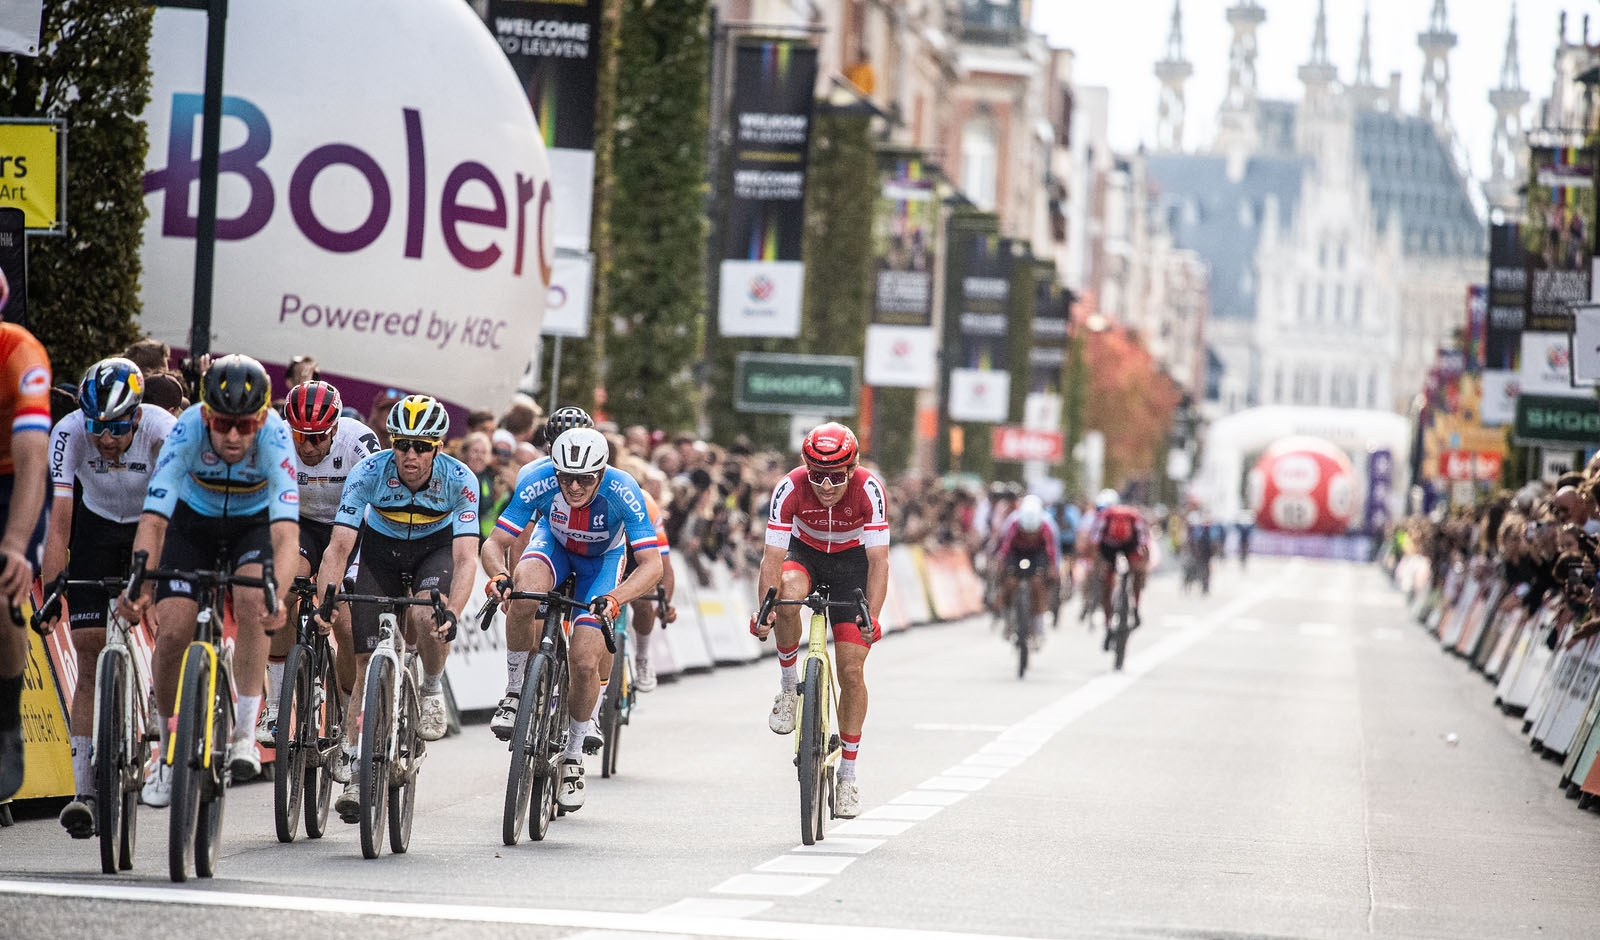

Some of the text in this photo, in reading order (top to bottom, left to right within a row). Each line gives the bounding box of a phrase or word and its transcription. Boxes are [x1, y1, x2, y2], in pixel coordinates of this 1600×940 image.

[495, 18, 591, 41] WELCOME
[521, 39, 590, 59] LEUVEN
[0, 185, 26, 201] Art
[279, 293, 507, 351] Powered by KBC
[338, 504, 357, 515] AG
